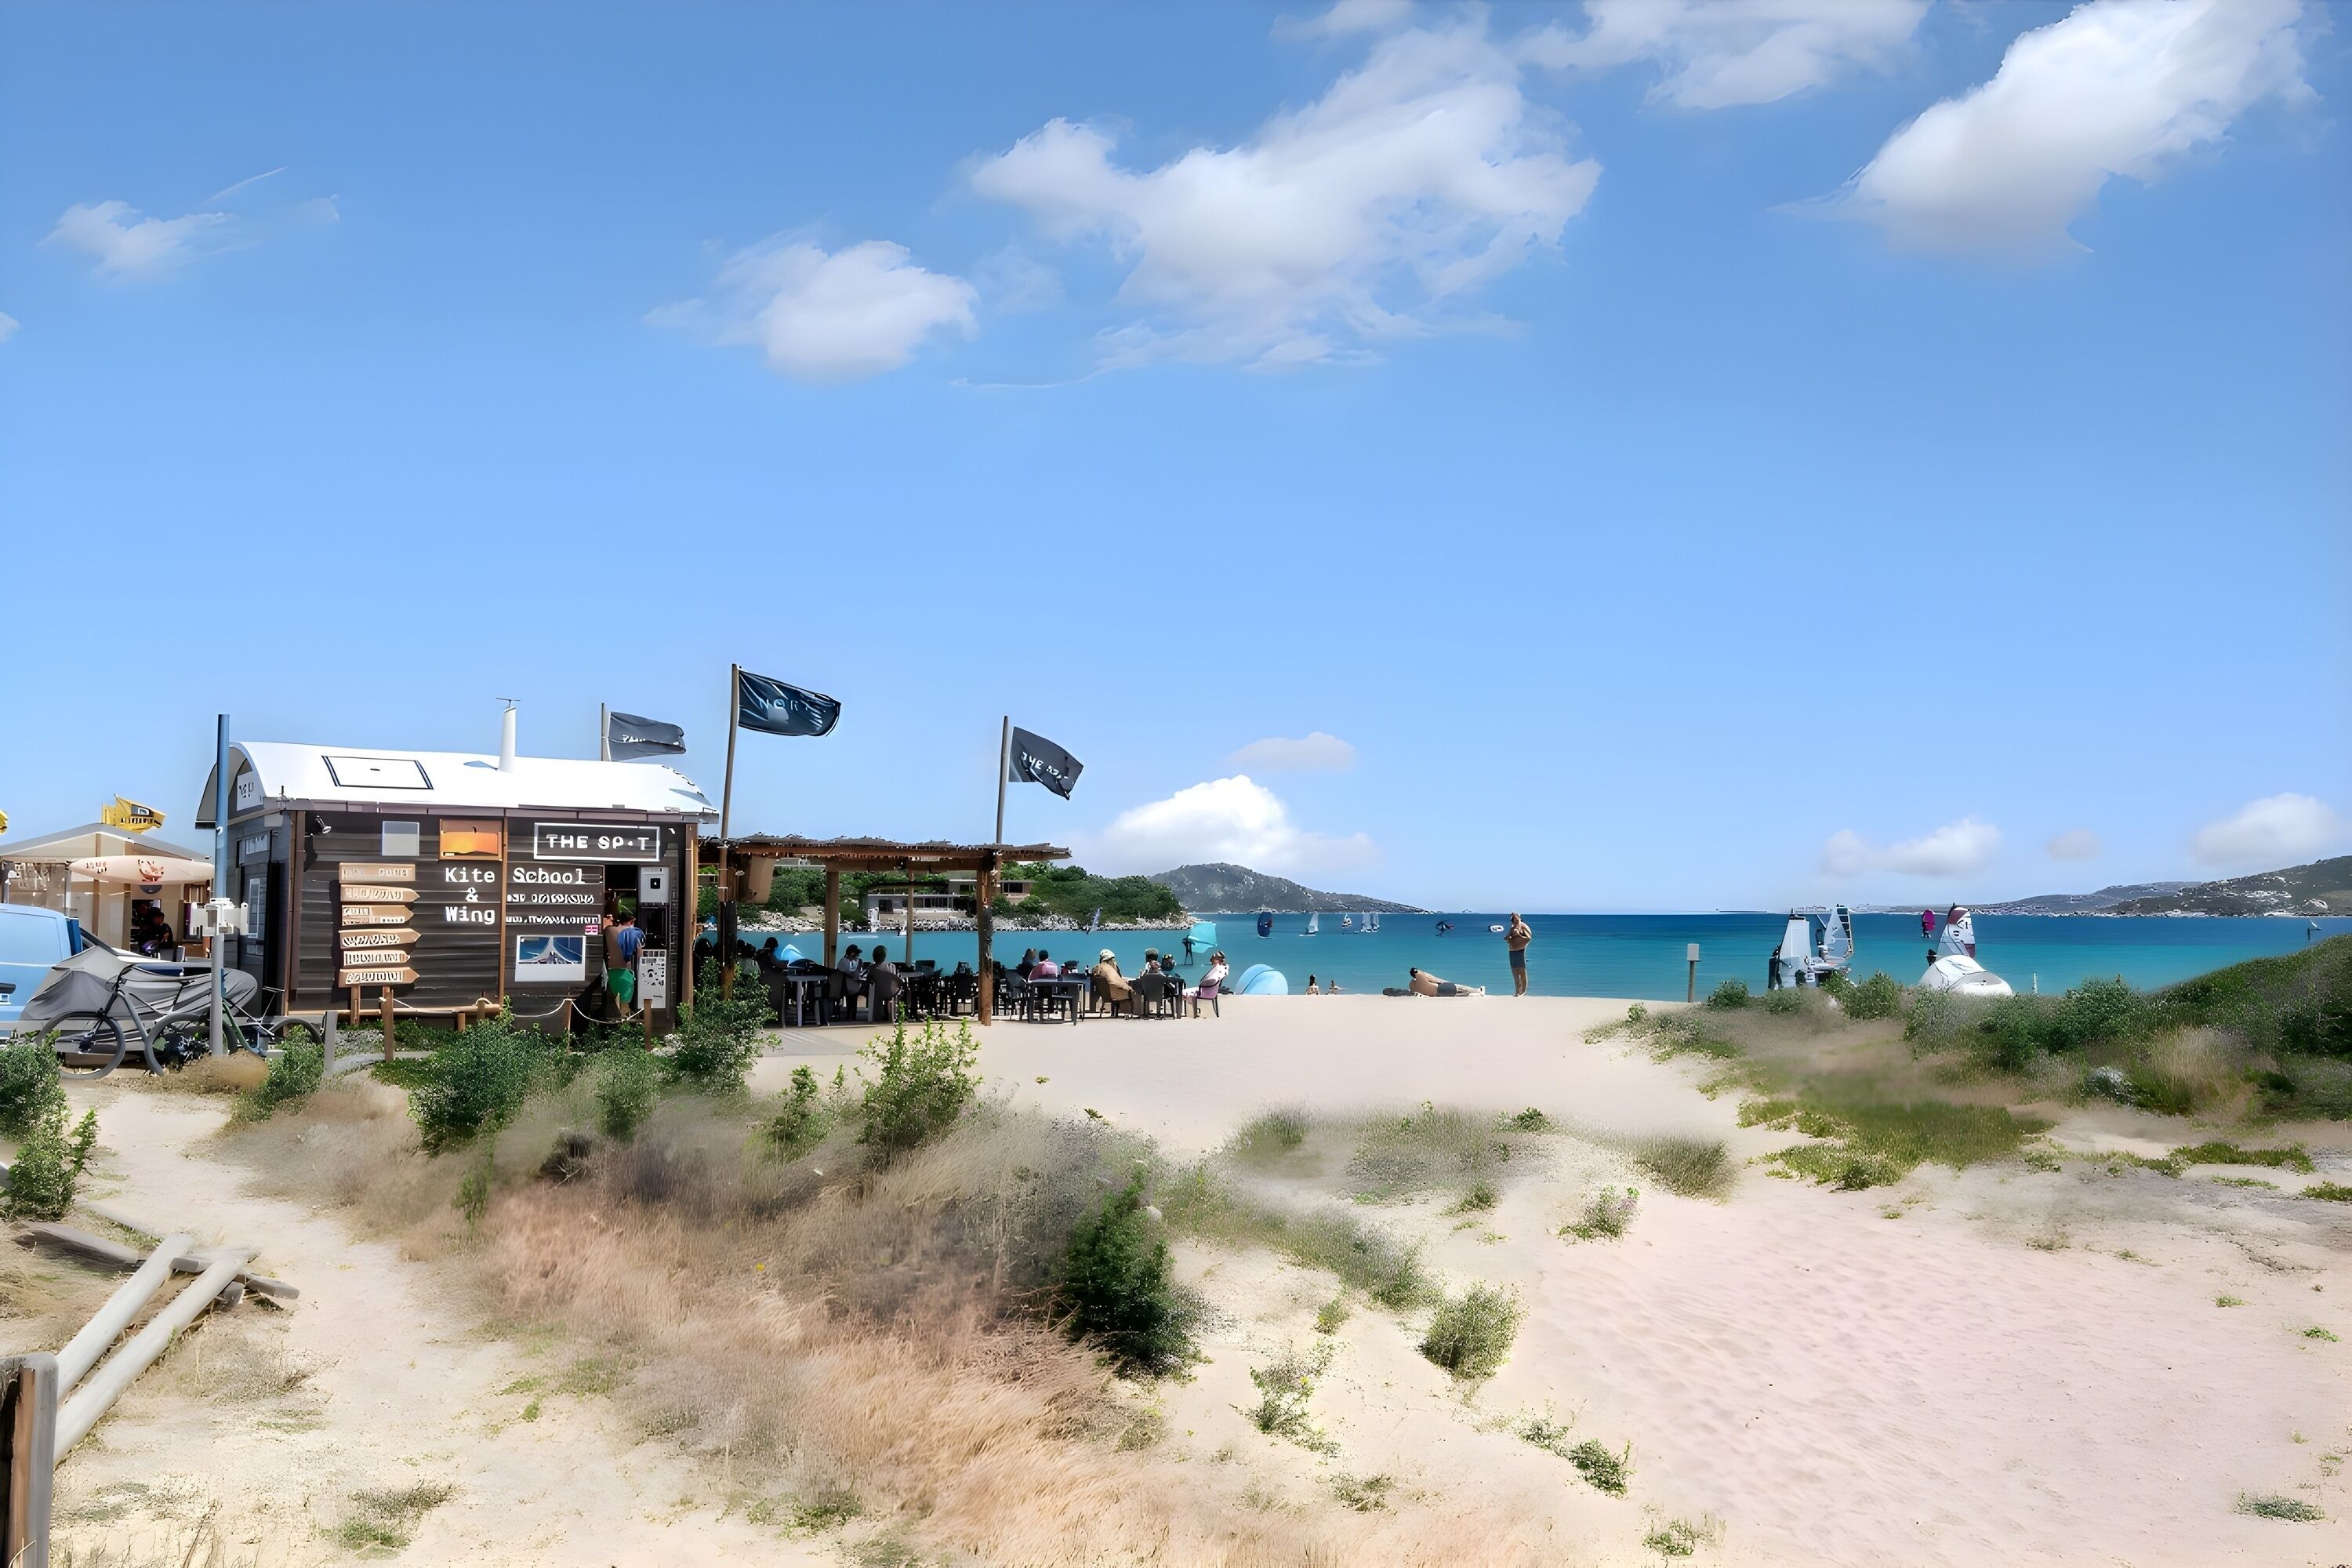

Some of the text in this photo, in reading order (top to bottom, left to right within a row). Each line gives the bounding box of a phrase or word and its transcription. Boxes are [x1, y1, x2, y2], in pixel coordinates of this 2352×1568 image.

[546, 833, 589, 849] THE
[445, 867, 586, 884] Kite School
[465, 887, 479, 902] &
[445, 906, 495, 925] Wing
